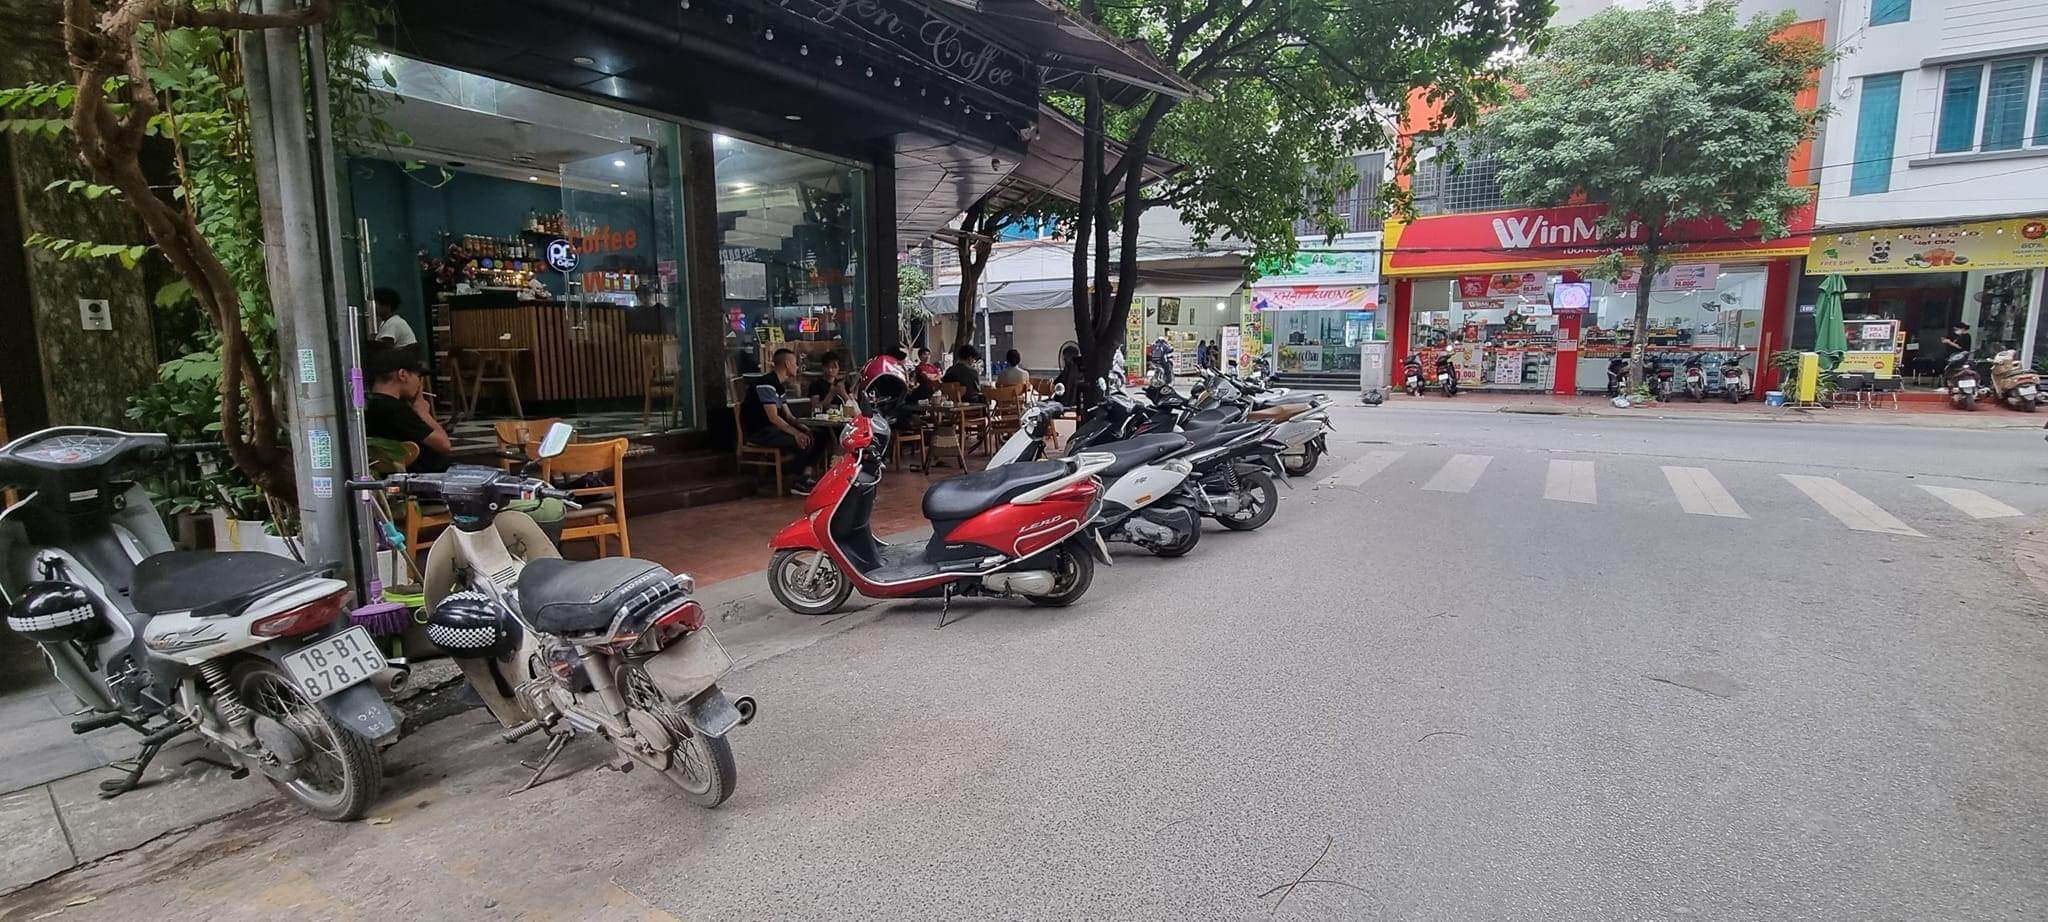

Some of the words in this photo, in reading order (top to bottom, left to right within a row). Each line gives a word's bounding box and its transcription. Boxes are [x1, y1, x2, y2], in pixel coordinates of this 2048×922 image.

[920, 19, 1014, 86] Coffee
[567, 224, 637, 256] Coffee
[1492, 215, 1642, 248] WinMar
[619, 573, 657, 594] HONDA
[299, 634, 362, 673] 18-B1
[303, 650, 381, 698] 878.15
